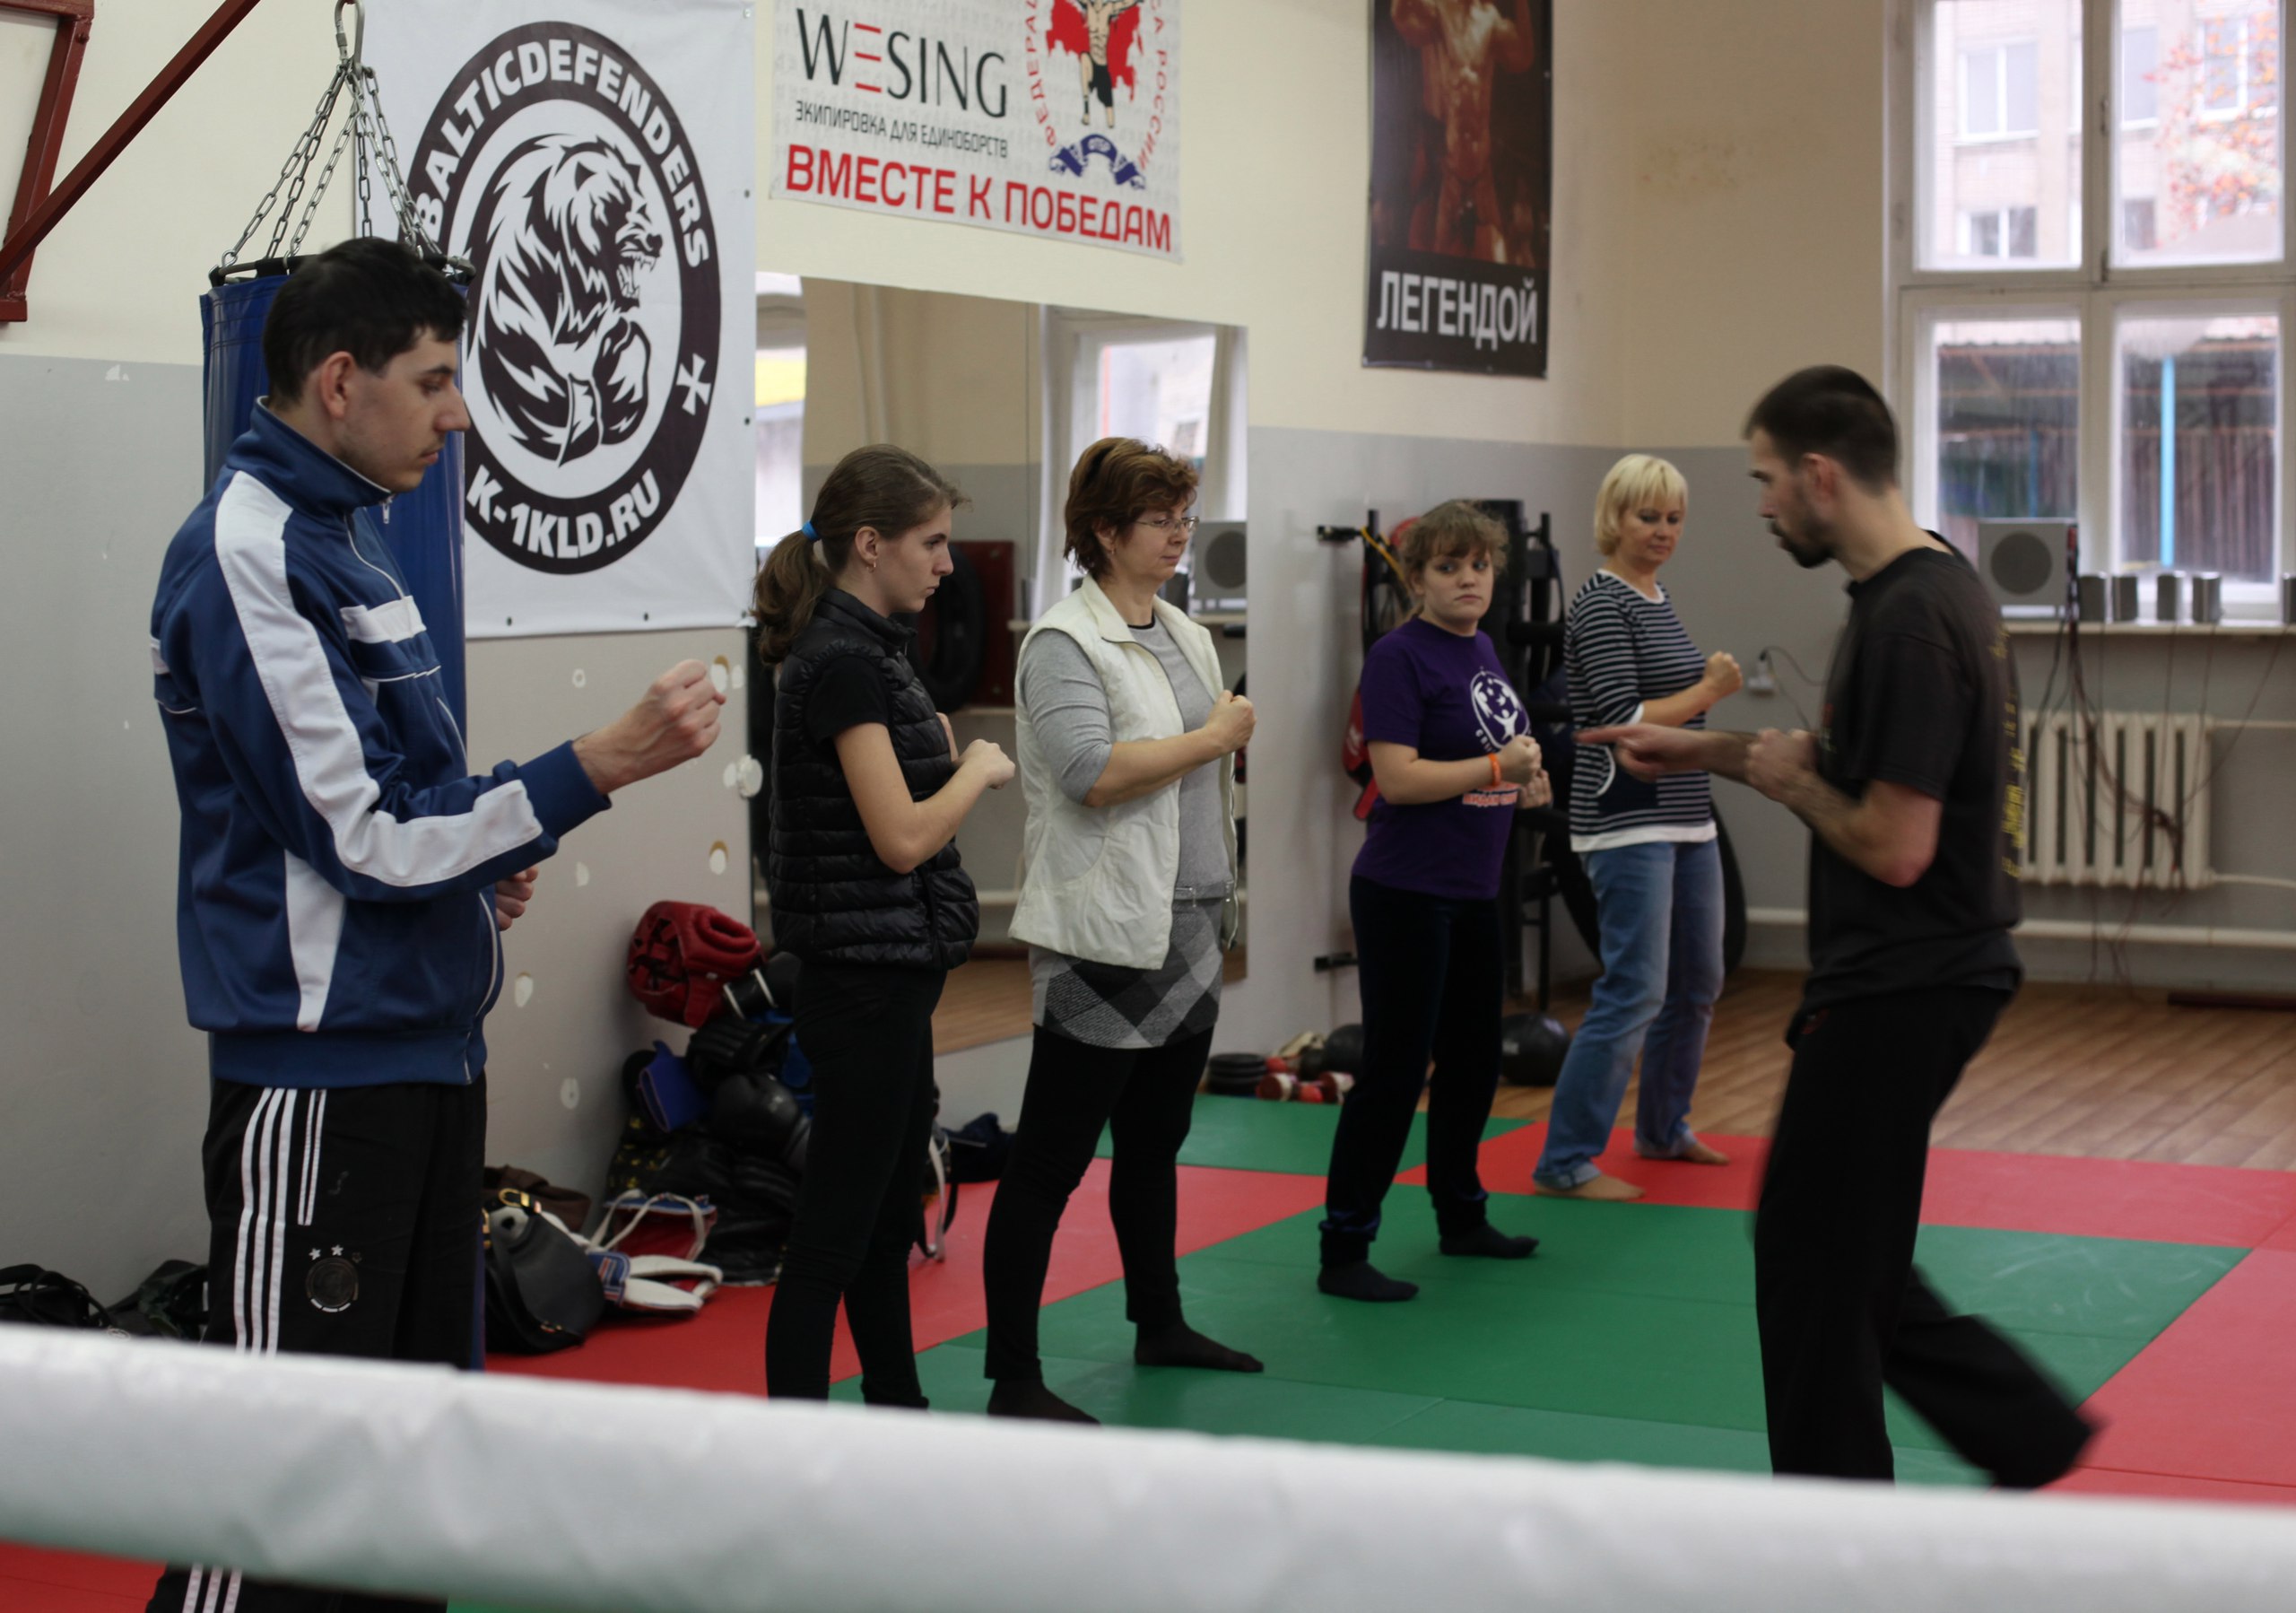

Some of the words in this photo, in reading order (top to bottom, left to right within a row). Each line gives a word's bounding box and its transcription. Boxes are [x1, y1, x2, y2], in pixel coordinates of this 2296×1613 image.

[796, 7, 1007, 118] WESING
[413, 39, 709, 267] BALTICDEFENDERS
[796, 100, 886, 137] ЭКИПИРОВКА
[890, 119, 918, 143] ДЛЯ
[921, 125, 1008, 158] ЕДИНОБОРСТВ
[786, 144, 957, 214] ВМЕСТЕ
[969, 174, 993, 221] К
[1005, 181, 1171, 253] ПОБЕДАМ
[1376, 270, 1537, 351] ЛЕГЕНДОЙ
[465, 464, 661, 559] K-1KLD.RU
